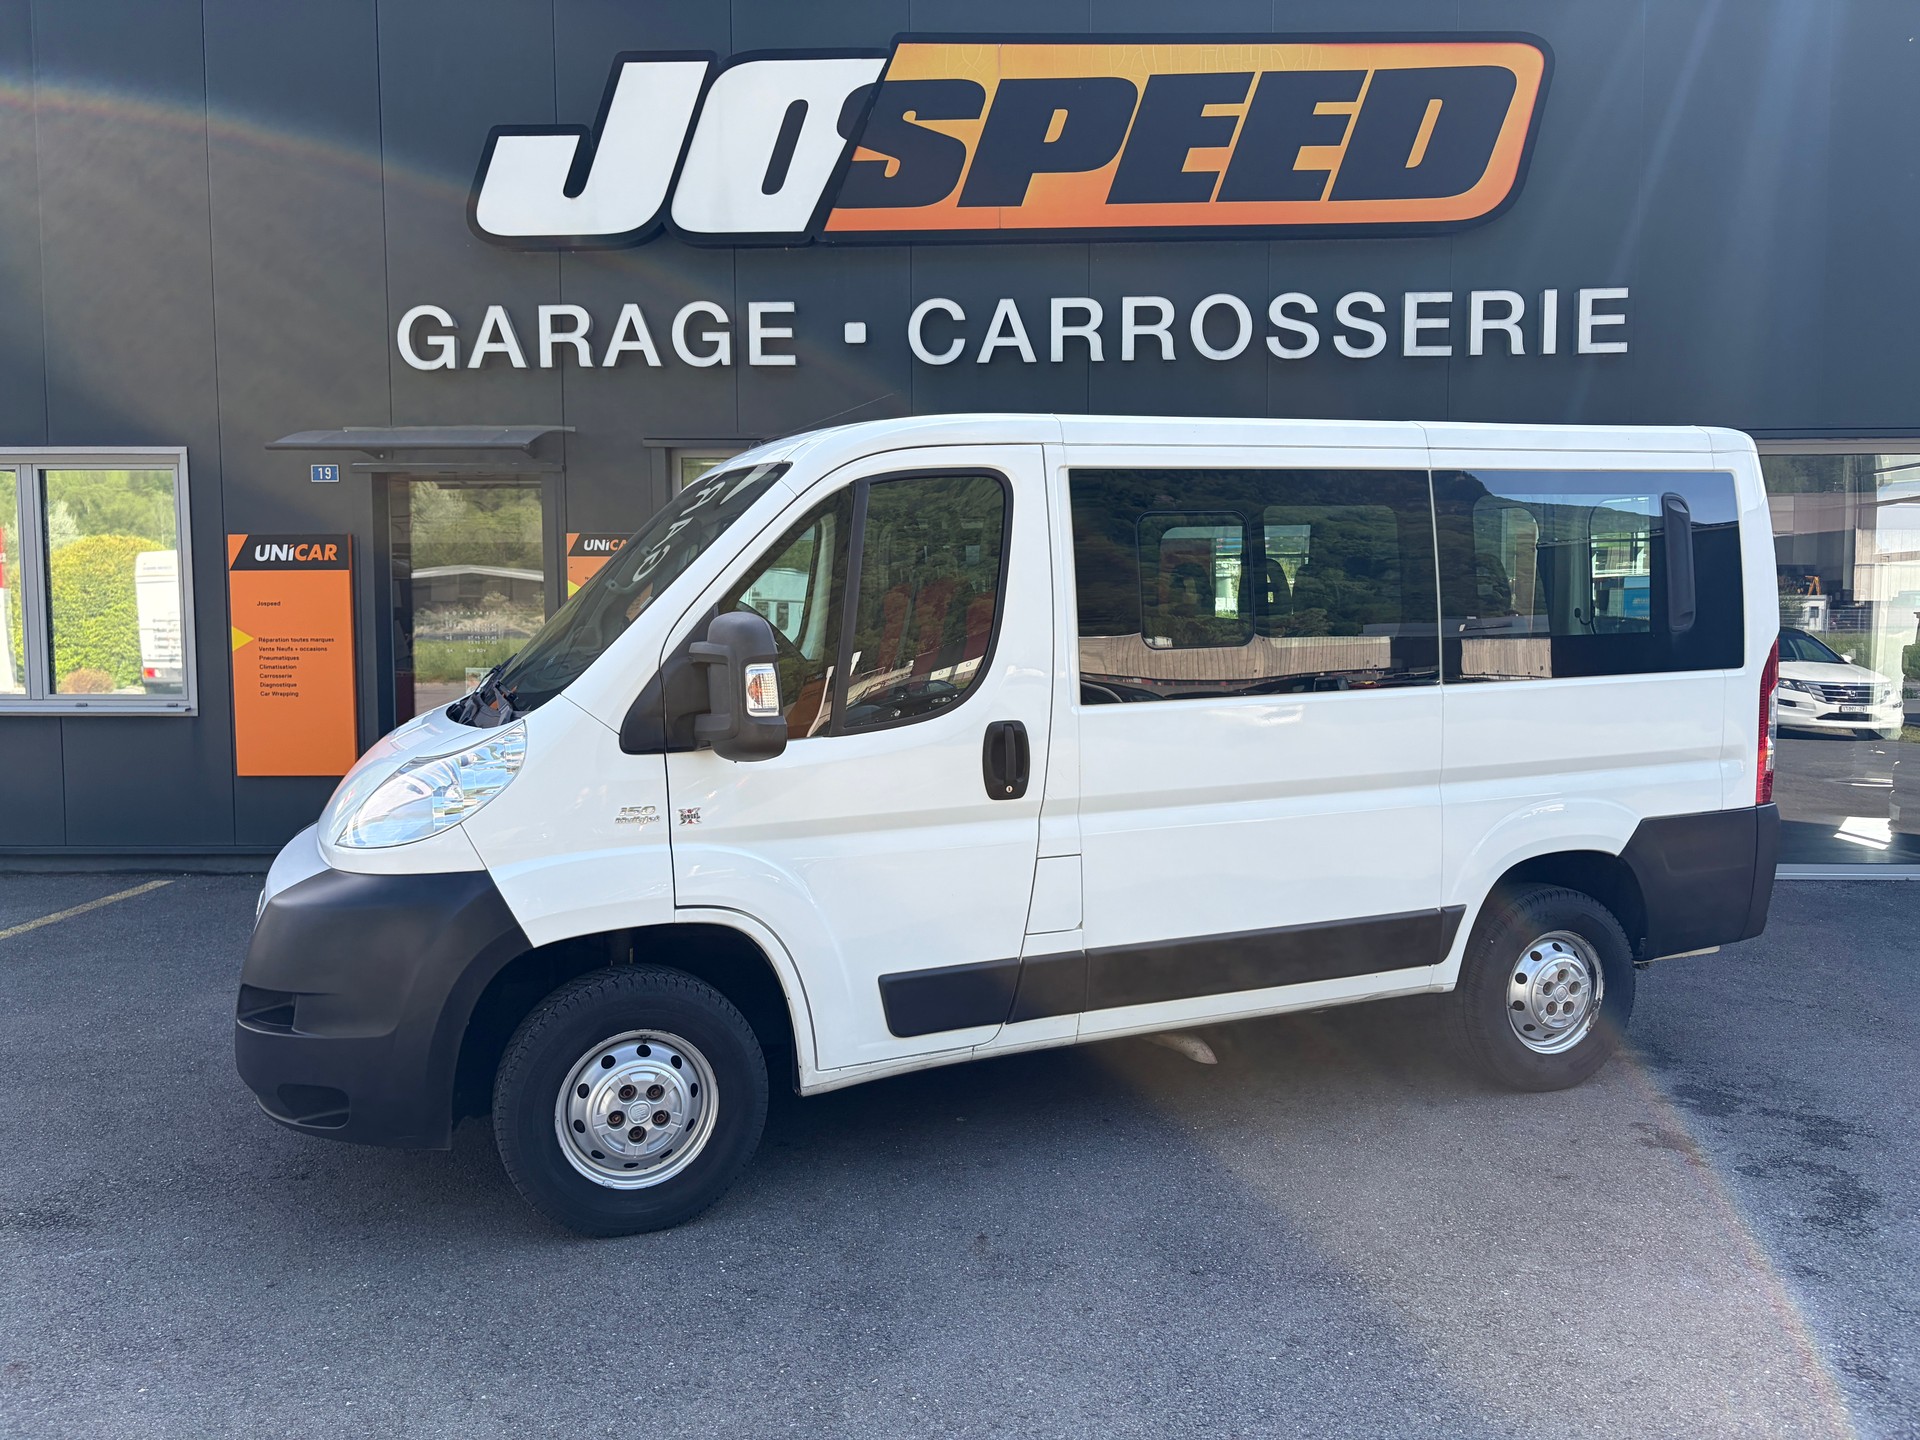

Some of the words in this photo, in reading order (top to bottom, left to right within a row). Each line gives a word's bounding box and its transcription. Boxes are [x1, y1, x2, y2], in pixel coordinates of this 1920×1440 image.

[475, 58, 1518, 236] JOSPEED
[396, 300, 798, 371] GARAGE
[907, 287, 1629, 366] CARROSSERIE
[318, 467, 332, 480] 19
